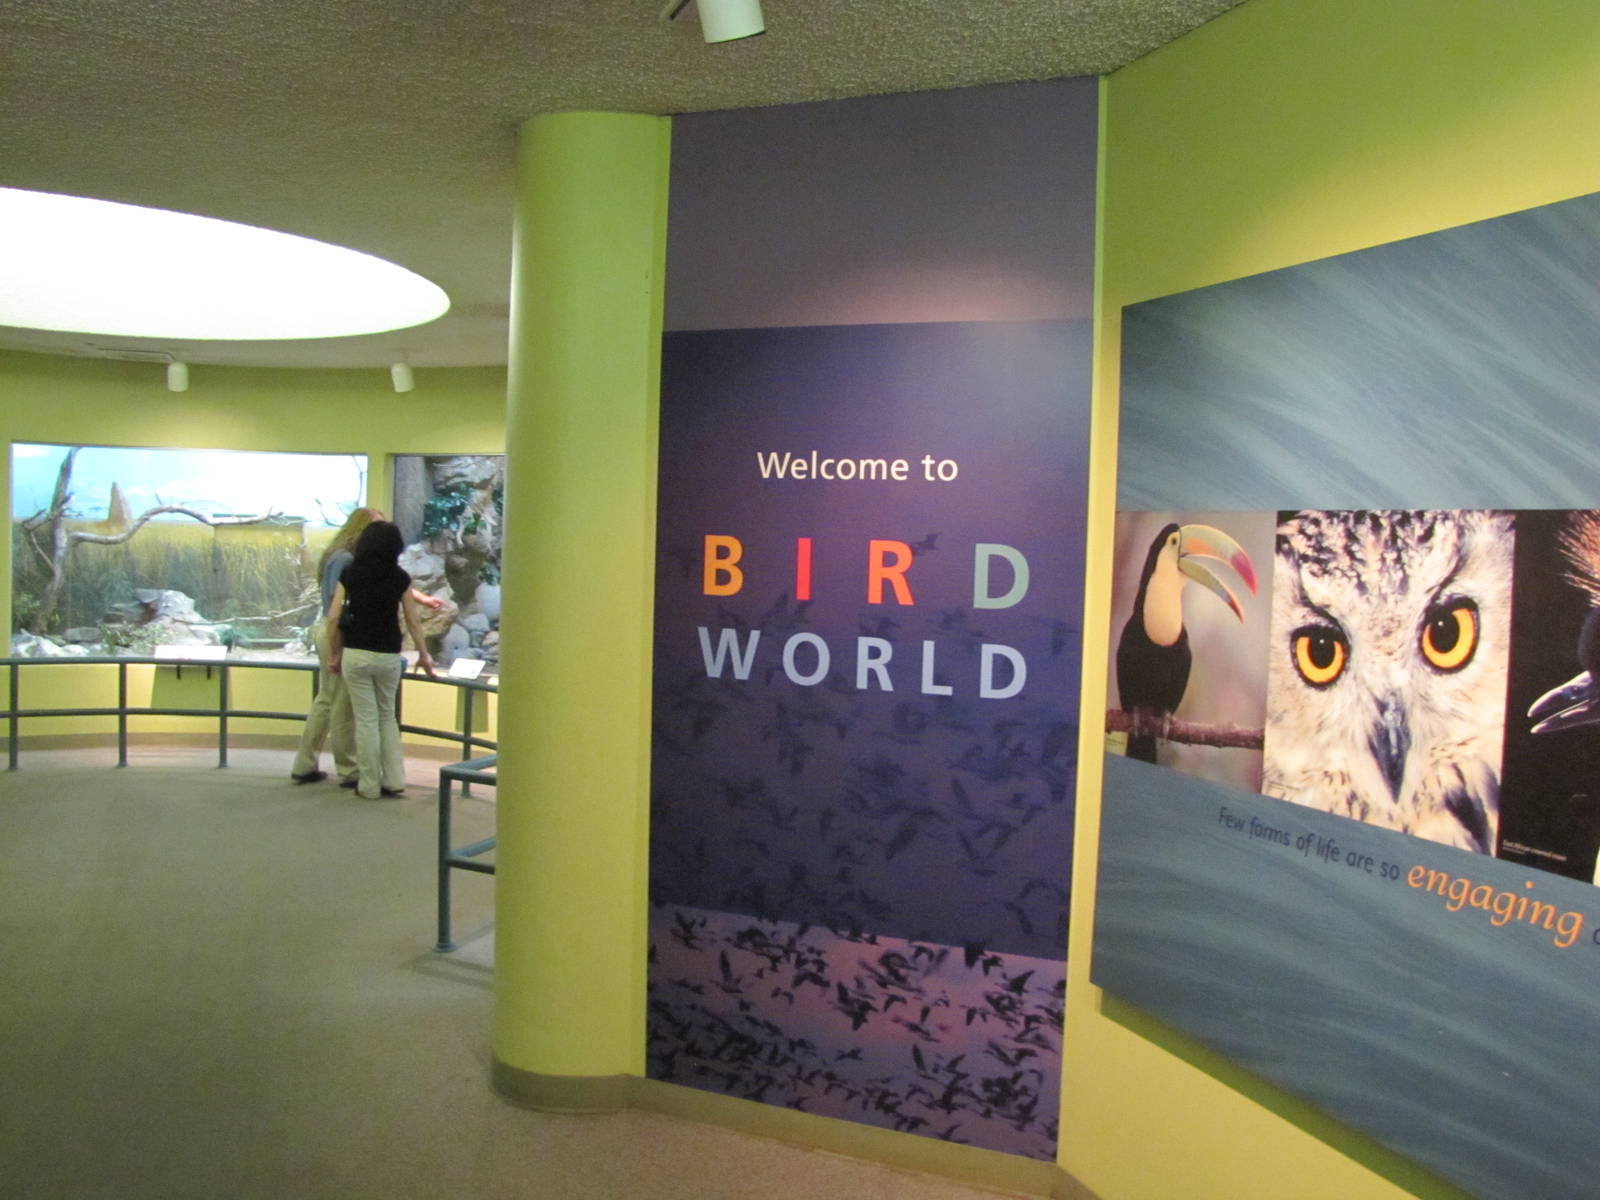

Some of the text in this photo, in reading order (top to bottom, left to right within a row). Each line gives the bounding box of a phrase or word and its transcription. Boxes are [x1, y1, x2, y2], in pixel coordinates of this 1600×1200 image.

[756, 450, 959, 481] Welcome to
[703, 534, 1030, 610] BIRD
[697, 626, 1028, 699] WORLD
[1218, 806, 1245, 831] Few
[1249, 816, 1291, 847] forms
[1296, 833, 1315, 858] of
[1316, 836, 1341, 864] life
[1345, 851, 1374, 874] are
[1380, 861, 1400, 881] so
[1407, 864, 1584, 948] engaging
